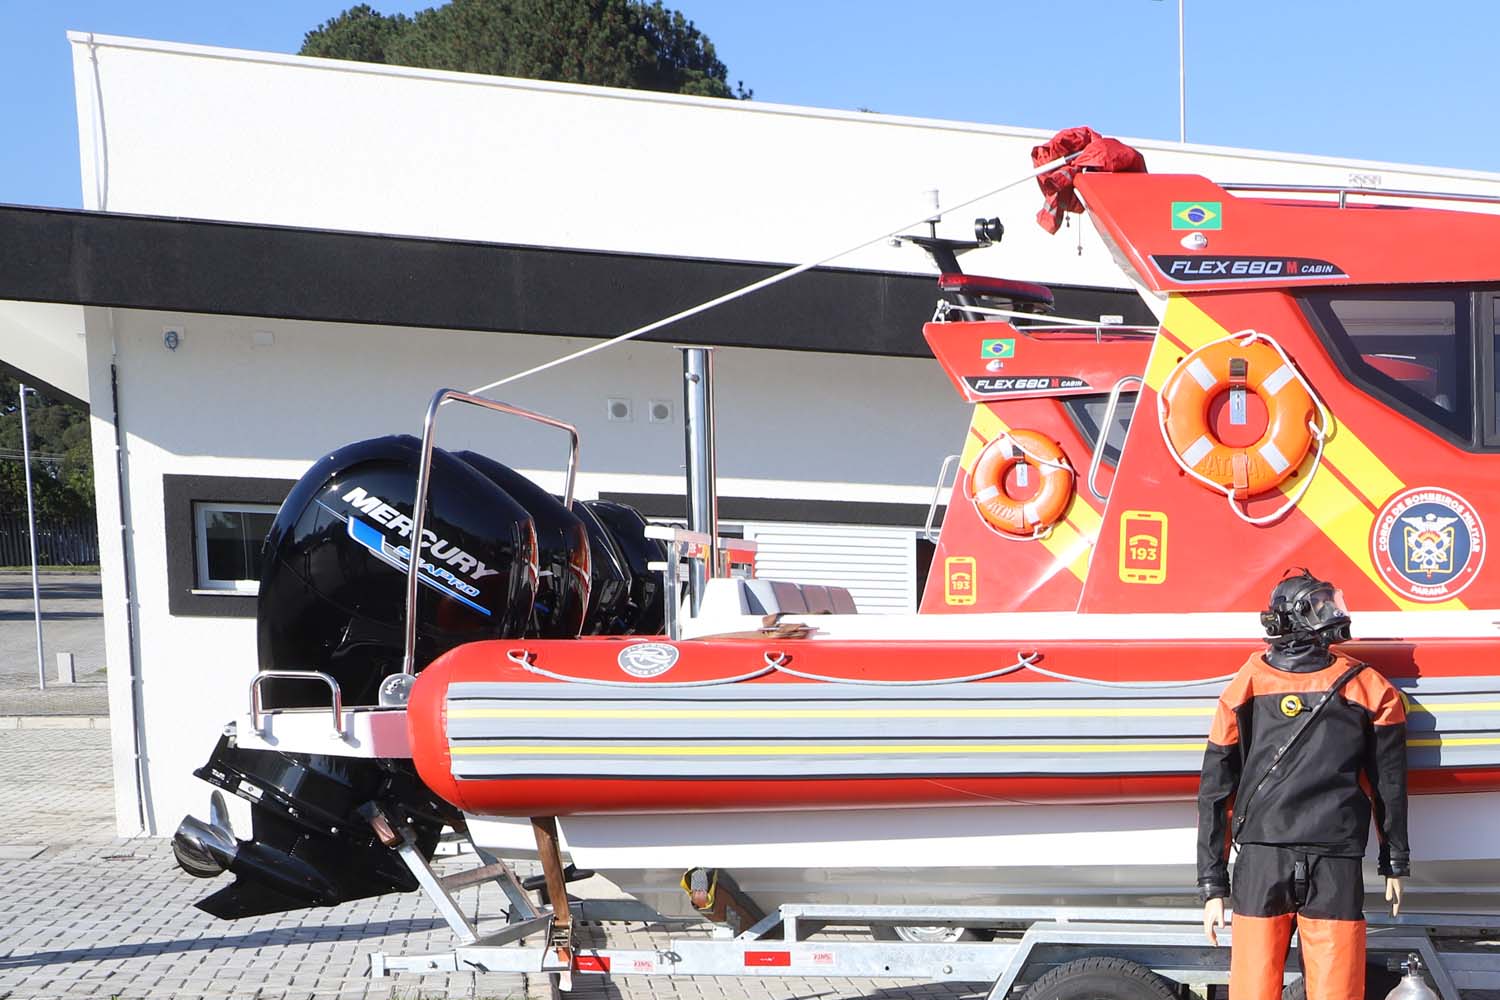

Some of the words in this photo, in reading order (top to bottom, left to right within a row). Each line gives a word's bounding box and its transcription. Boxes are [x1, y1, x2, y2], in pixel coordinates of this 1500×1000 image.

[1170, 261, 1230, 274] FLEX
[1231, 261, 1283, 274] 680
[1301, 265, 1334, 273] CABIN
[975, 379, 1015, 389] FLEX
[1015, 378, 1049, 388] 680
[1379, 514, 1394, 552] CORPO
[1391, 502, 1406, 516] DE
[1404, 492, 1465, 514] BOMBEIROS
[1462, 510, 1481, 553] MILITAR
[341, 486, 499, 580] MERCURY
[1130, 547, 1157, 560] 193
[393, 545, 481, 597] SAPRO
[952, 581, 970, 590] 193
[1410, 584, 1449, 595] PARANÁ
